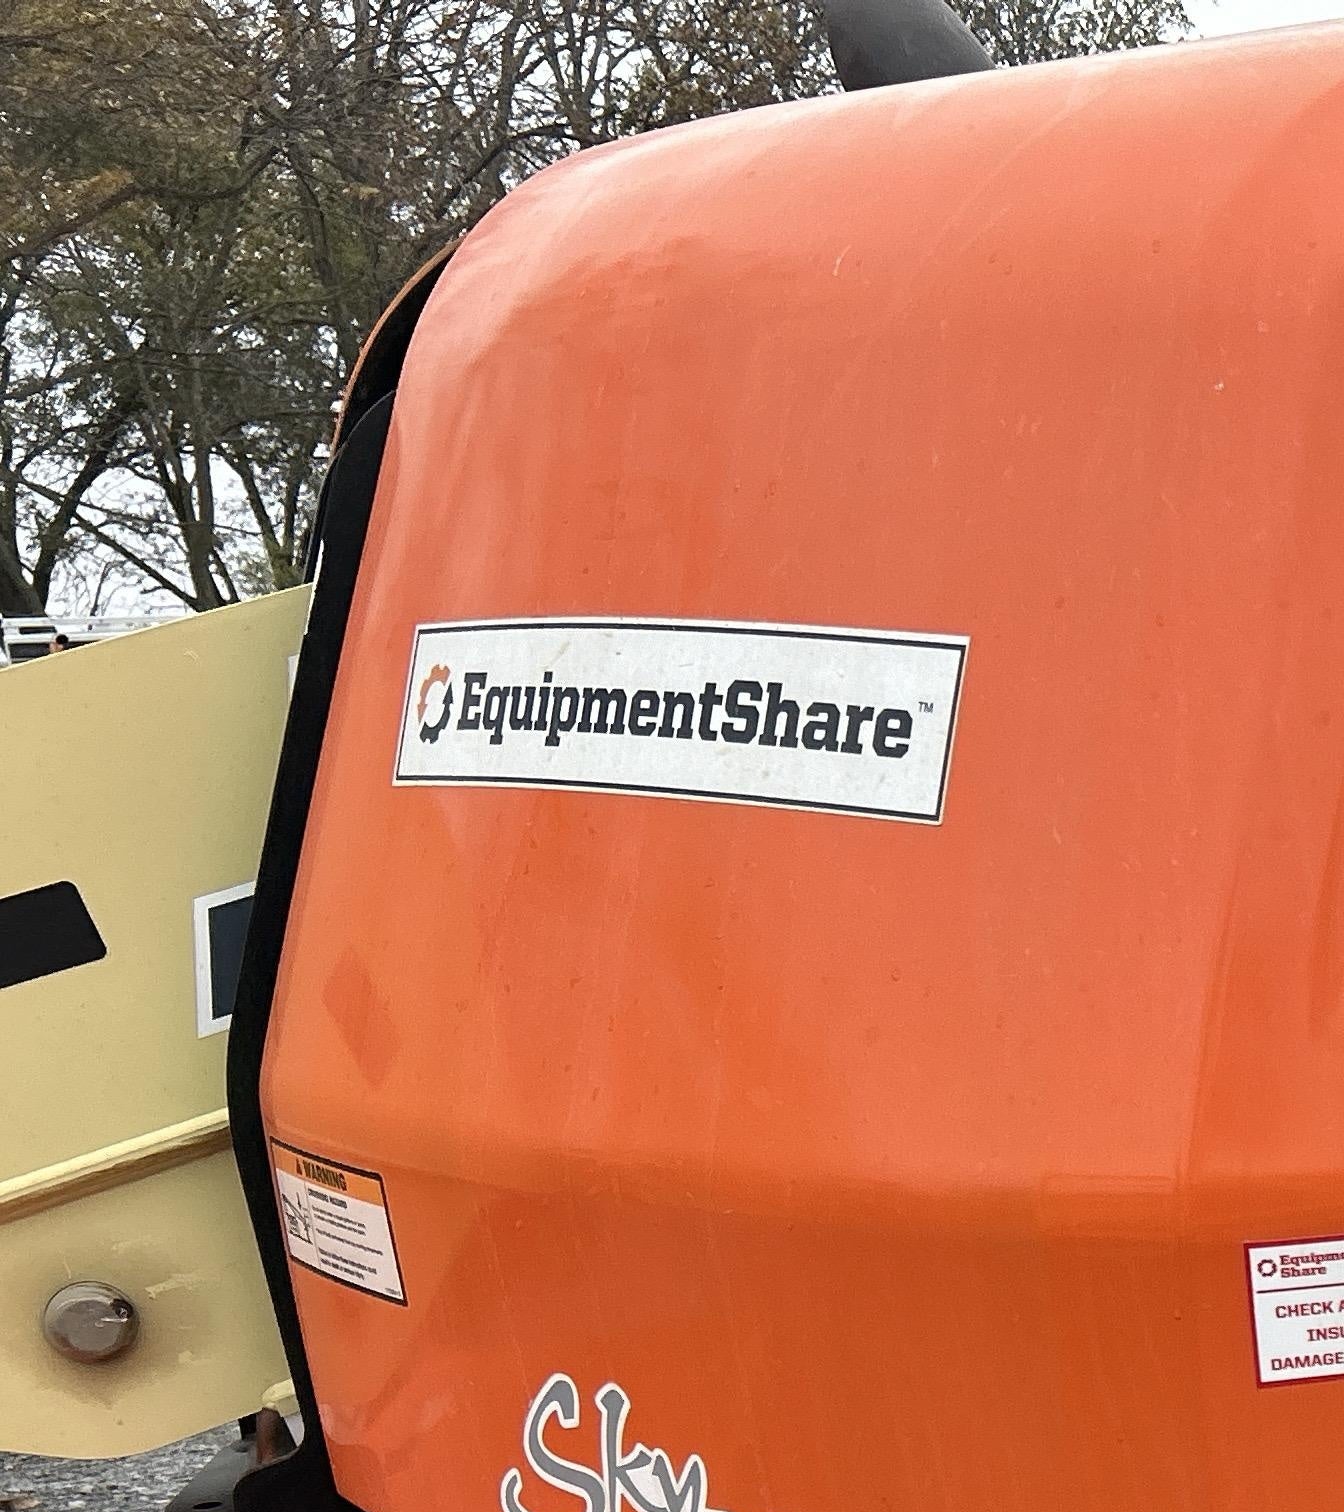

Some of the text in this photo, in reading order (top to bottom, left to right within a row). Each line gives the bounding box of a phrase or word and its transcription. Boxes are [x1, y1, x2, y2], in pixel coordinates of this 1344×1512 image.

[457, 670, 913, 759] EquipmentShare
[303, 1160, 347, 1191] WARNING
[1280, 1263, 1326, 1279] Share
[1275, 1300, 1333, 1319] CHECK
[1270, 1351, 1344, 1371] DAMAGE
